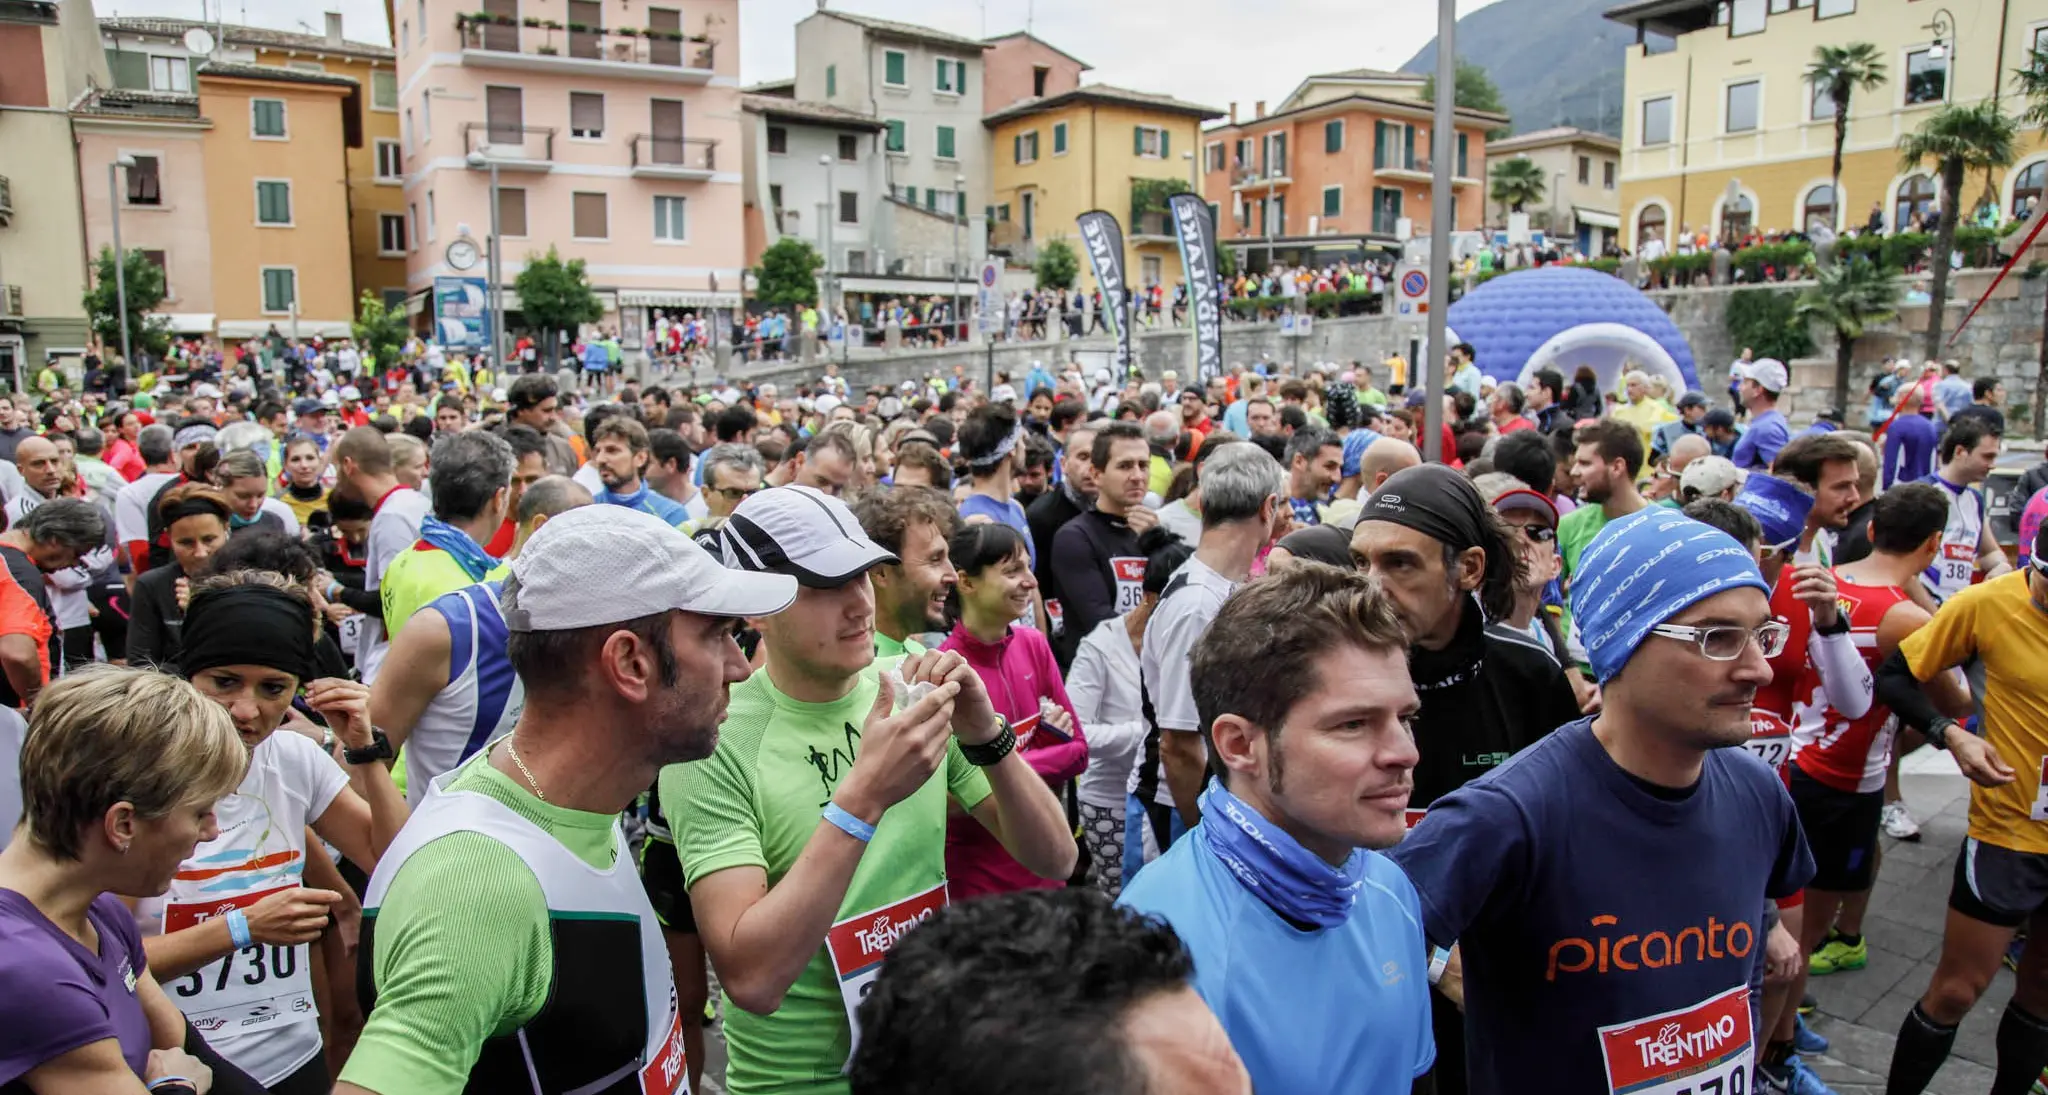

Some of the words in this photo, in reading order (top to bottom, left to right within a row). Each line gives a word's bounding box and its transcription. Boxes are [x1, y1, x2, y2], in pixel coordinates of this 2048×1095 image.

[1122, 585, 1142, 607] 36
[1599, 539, 1684, 613] BROOKS
[1592, 610, 1632, 650] BRO
[1546, 914, 1753, 981] picanto
[1635, 1015, 1735, 1068] TRENTINO
